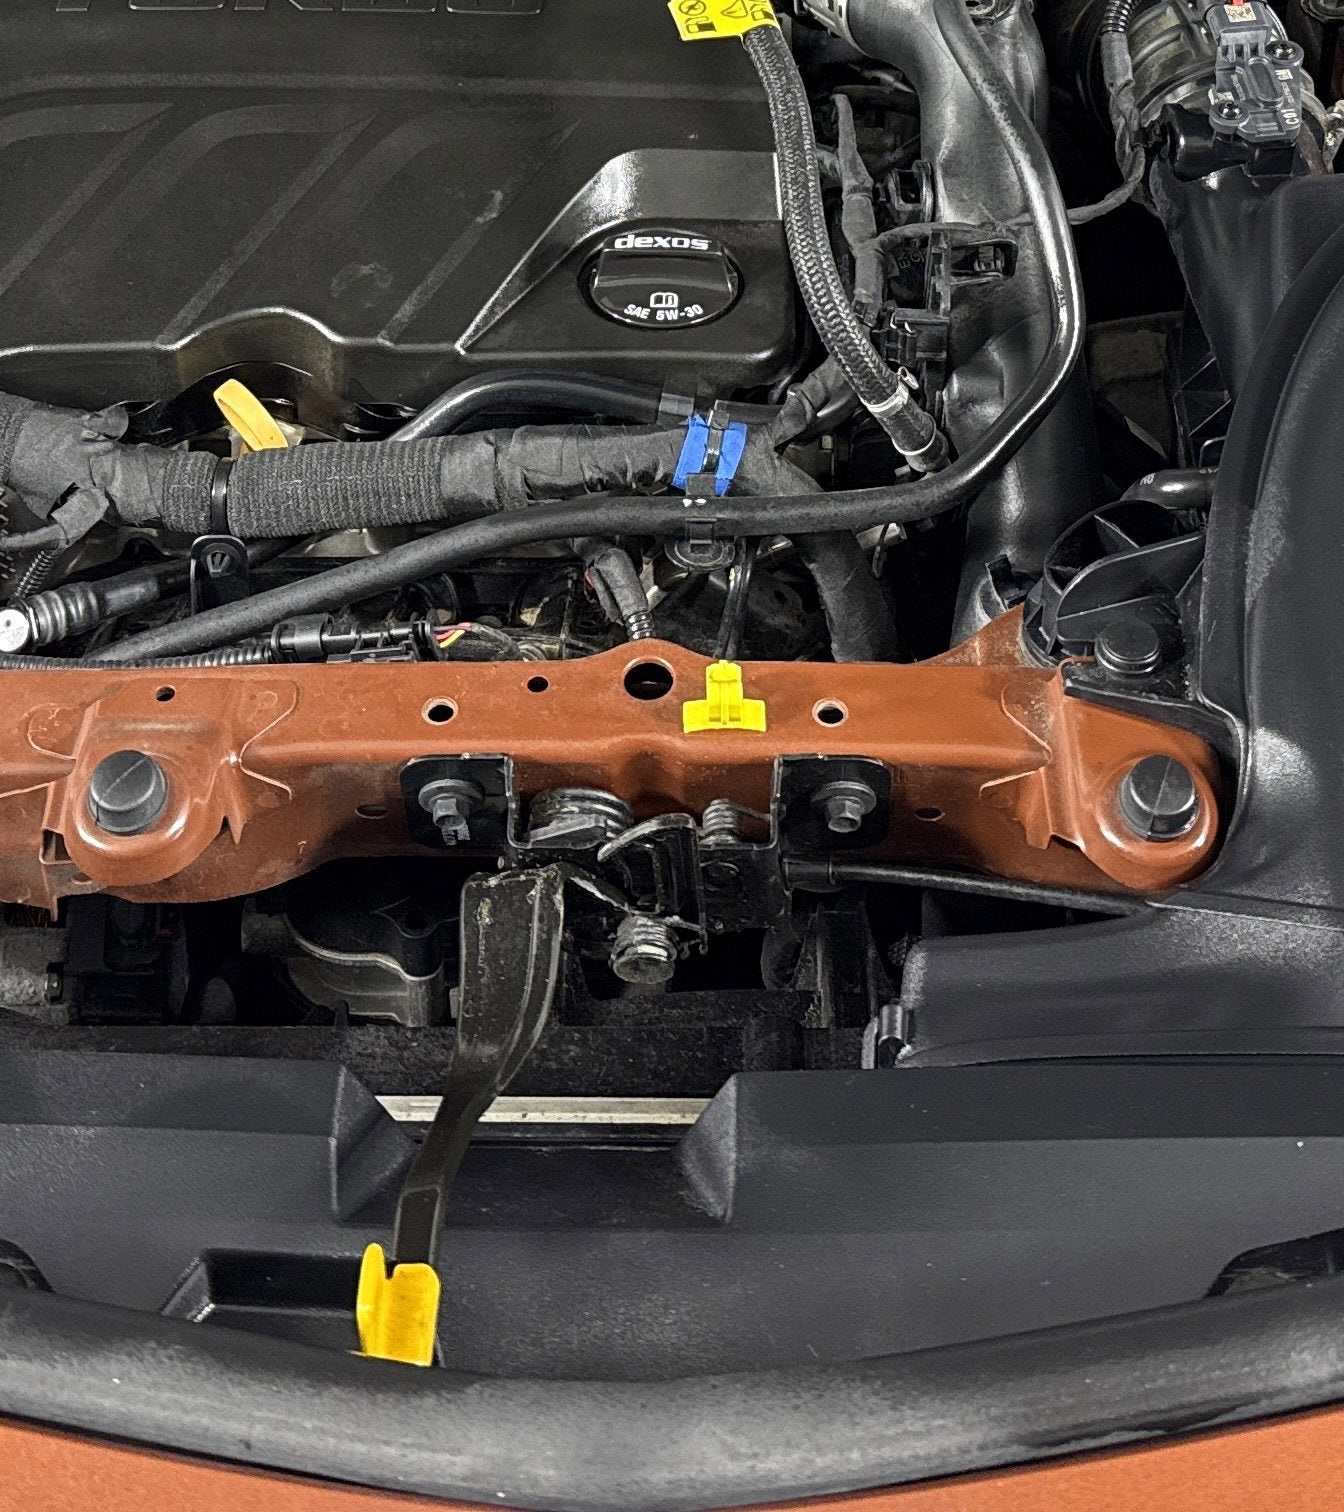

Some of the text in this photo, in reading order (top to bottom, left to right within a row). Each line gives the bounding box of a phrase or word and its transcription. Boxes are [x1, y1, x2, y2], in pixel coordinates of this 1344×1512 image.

[613, 234, 711, 251] dexos
[623, 303, 704, 321] SAE 5W-30
